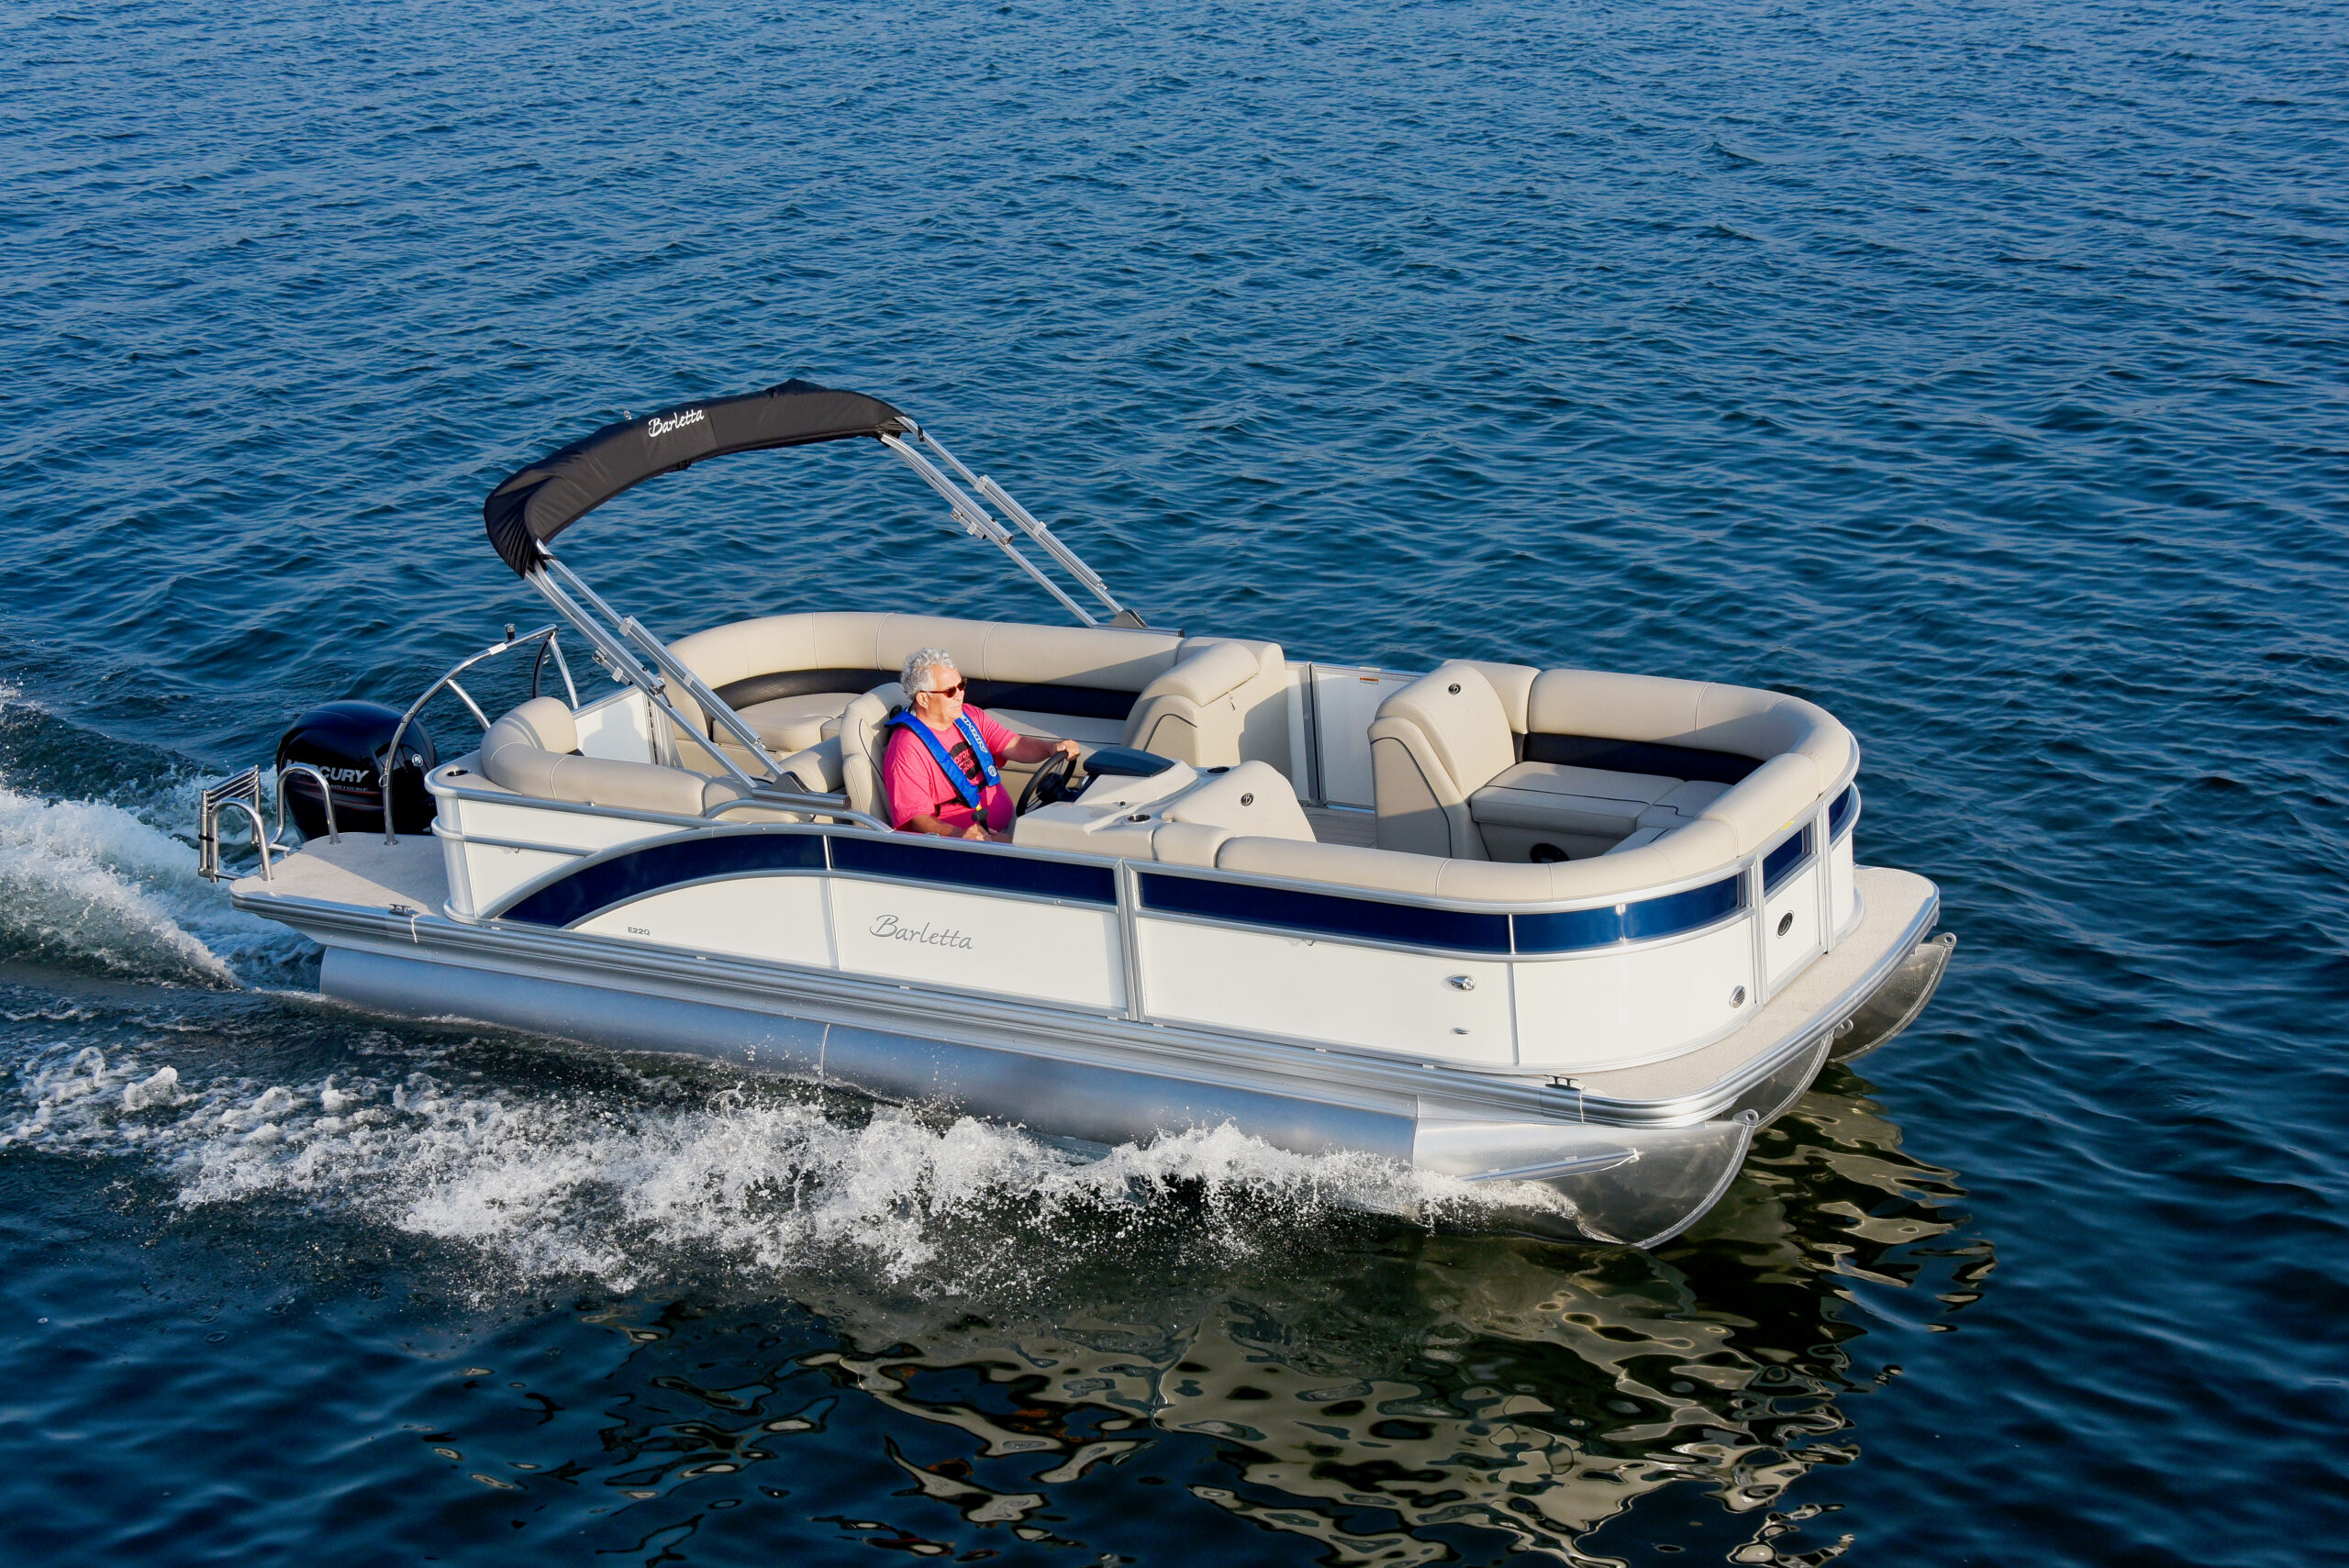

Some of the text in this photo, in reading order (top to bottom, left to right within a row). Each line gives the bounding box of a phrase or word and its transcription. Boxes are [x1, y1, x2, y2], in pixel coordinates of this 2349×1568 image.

[648, 408, 705, 438] Barletta
[628, 926, 651, 936] E22Q
[869, 914, 974, 950] Barletta
